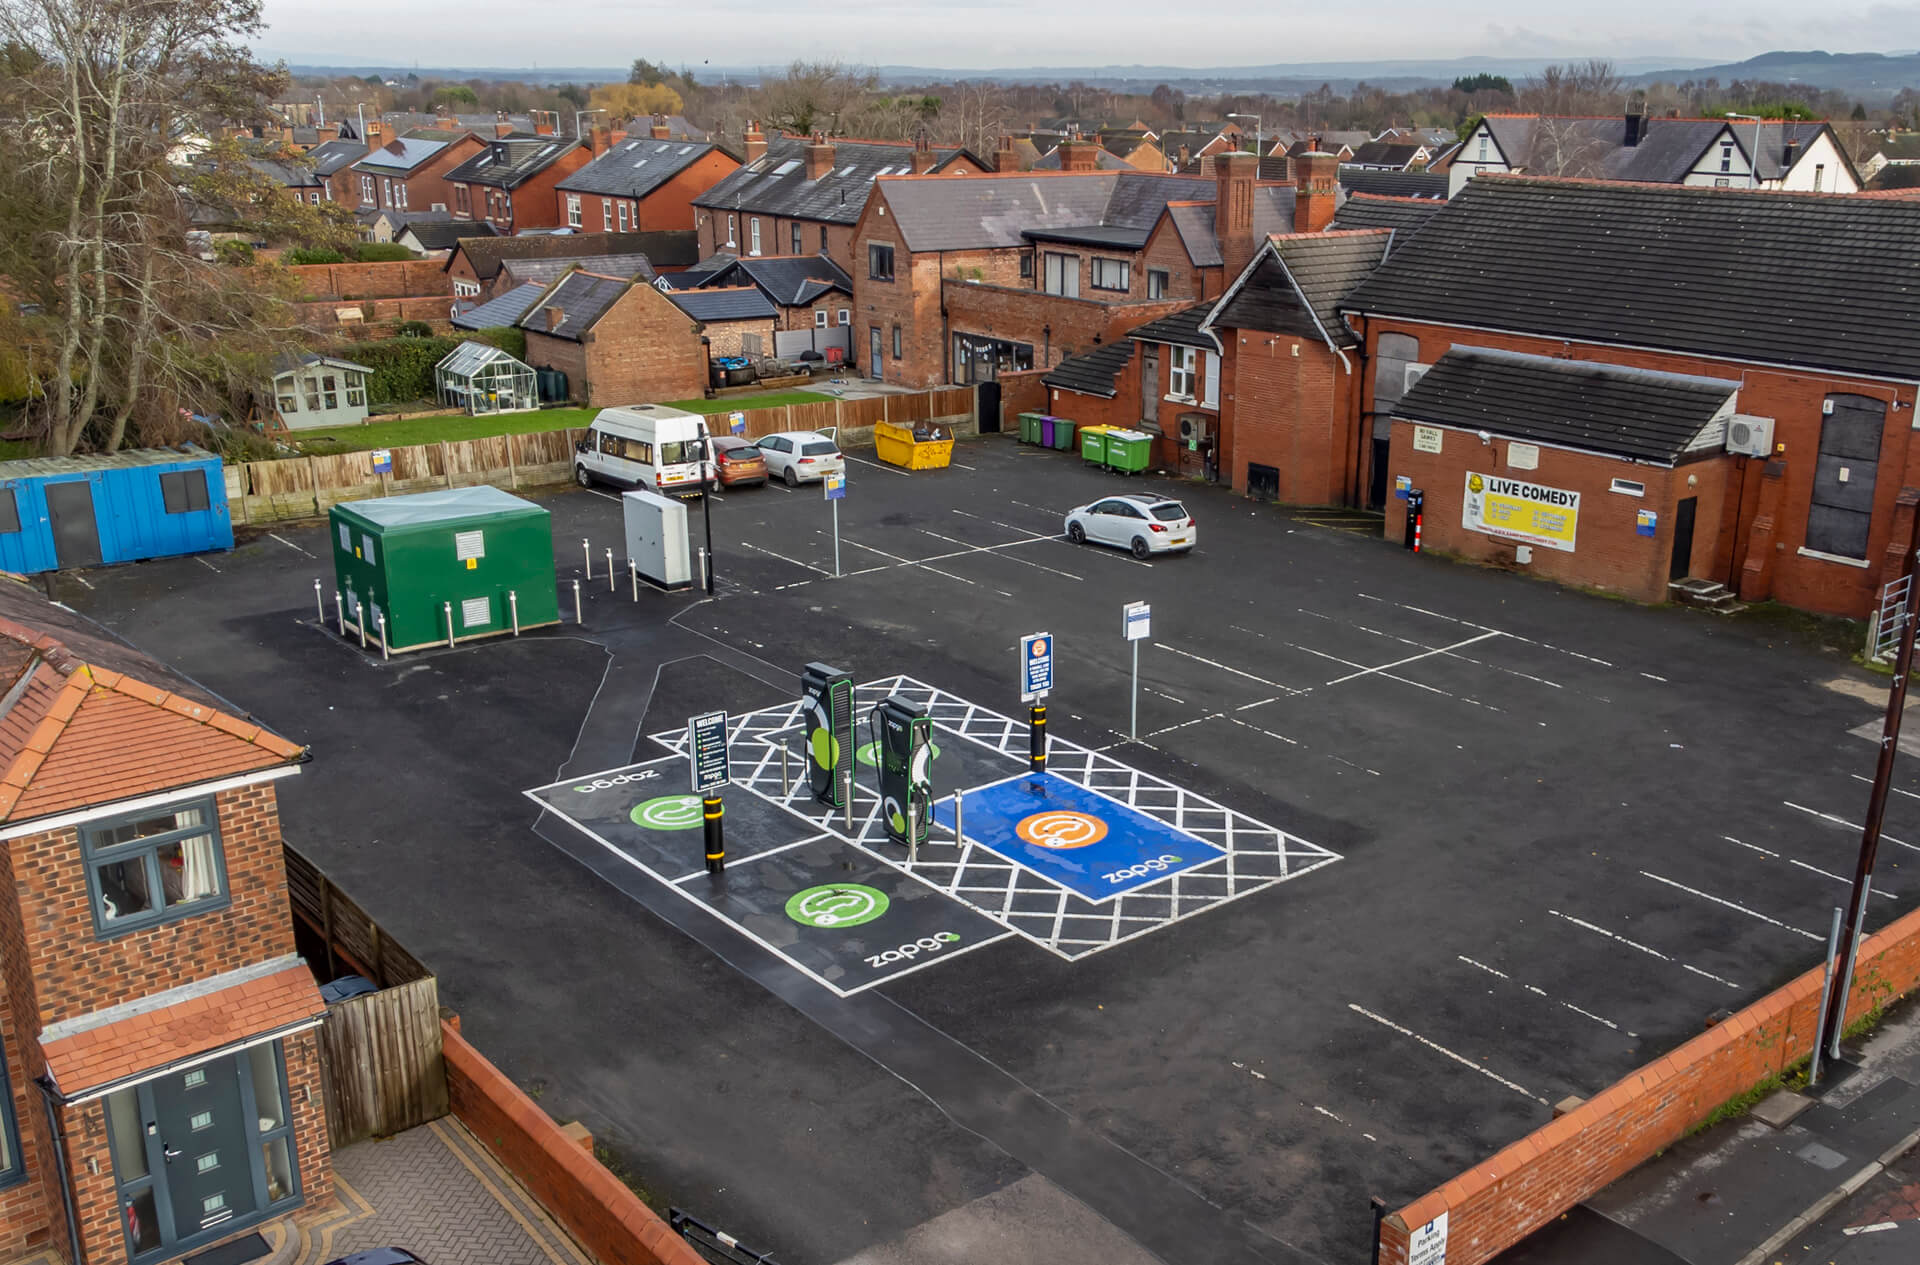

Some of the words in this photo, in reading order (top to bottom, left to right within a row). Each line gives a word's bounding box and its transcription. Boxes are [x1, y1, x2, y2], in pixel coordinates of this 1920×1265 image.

[1489, 479, 1519, 496] LIVE
[1522, 485, 1577, 507] COMEDY
[696, 714, 724, 729] WELCOME
[573, 769, 661, 793] zapgo
[1101, 854, 1183, 884] zapgo
[863, 931, 961, 968] zapgo
[1410, 1248, 1429, 1263] Terms
[1430, 1238, 1445, 1252] Apply
[1417, 1230, 1439, 1248] Parking
